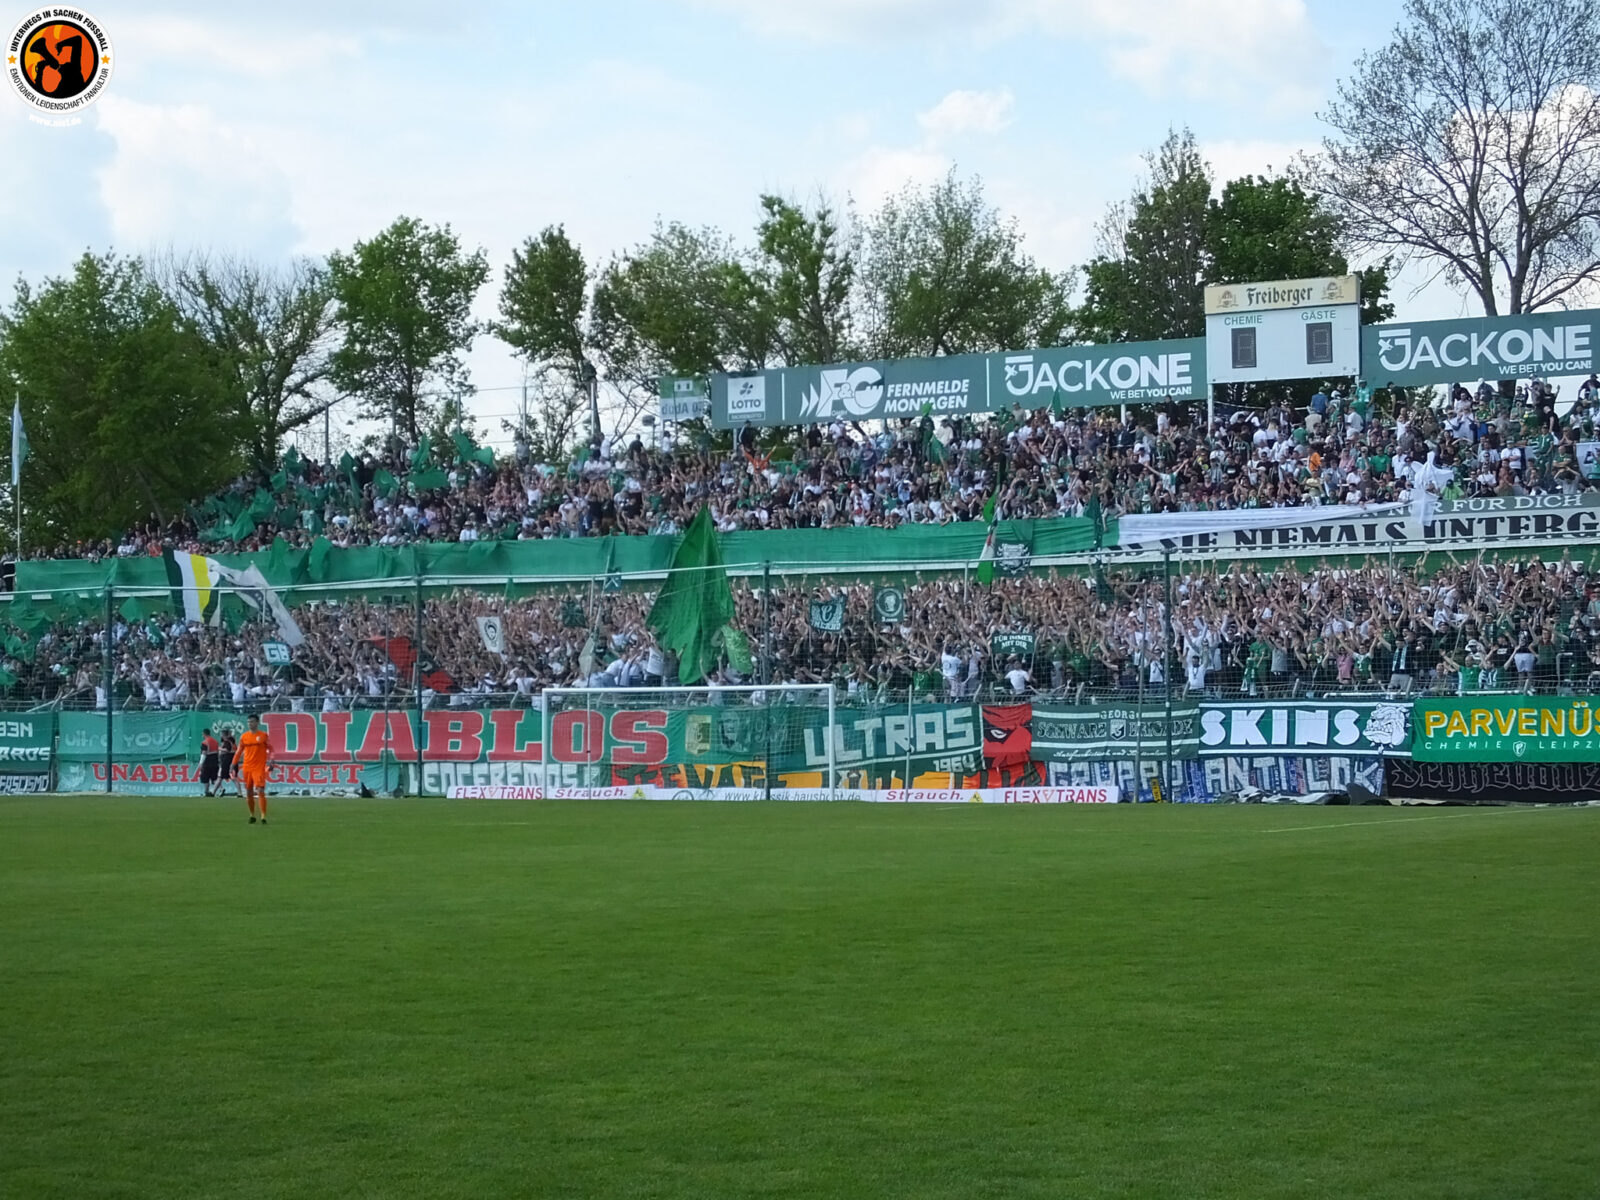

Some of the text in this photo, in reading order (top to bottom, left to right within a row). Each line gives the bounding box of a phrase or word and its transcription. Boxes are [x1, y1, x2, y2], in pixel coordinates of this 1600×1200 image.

[1246, 287, 1313, 306] Freiberger
[1224, 315, 1263, 326] CHEMIE
[1378, 324, 1593, 371] JACKONE
[1005, 352, 1193, 396] JACKONE
[1499, 360, 1593, 375] WE BET YOU CAN!
[887, 379, 969, 398] FERNMELDE
[1110, 386, 1193, 399] WE BET YOU CAN!
[731, 399, 761, 409] LOTTO
[884, 395, 968, 413] MONTAGEN
[1452, 498, 1506, 512] FÜR
[1515, 494, 1583, 509] DICH
[1234, 521, 1407, 552] NIEMALS
[994, 634, 1033, 644] FÜR IMMER
[1001, 640, 1014, 649] MIT
[1100, 710, 1136, 720] GEORG
[1424, 701, 1600, 738] PARVENÜ
[804, 707, 975, 766] ULTRAS
[1200, 709, 1361, 746] SKINS
[261, 709, 669, 765] DIABLOS
[1425, 741, 1502, 750] CHEMIE
[933, 754, 976, 772] 1964
[555, 788, 627, 798] Strauch.
[886, 790, 964, 801] Strauch.
